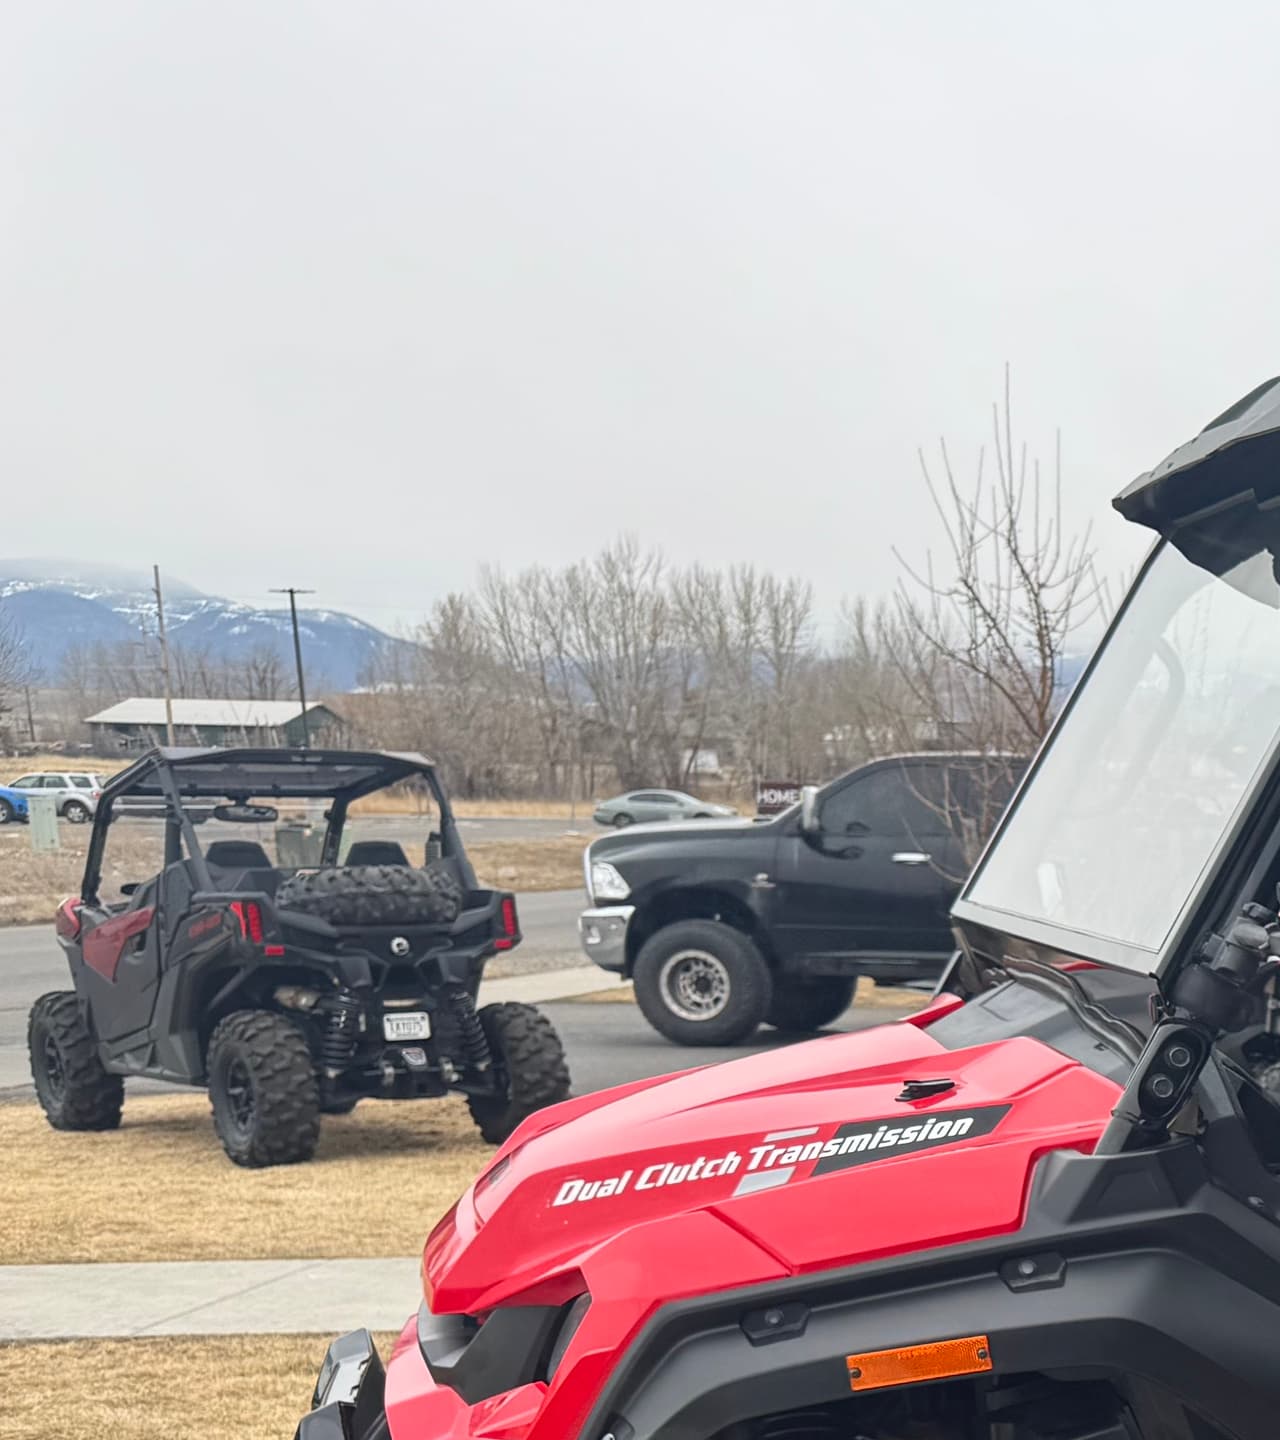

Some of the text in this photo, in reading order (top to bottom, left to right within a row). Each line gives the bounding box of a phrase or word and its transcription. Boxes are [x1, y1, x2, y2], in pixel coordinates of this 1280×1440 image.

[552, 1116, 974, 1207] Dual Clutch Transmission
